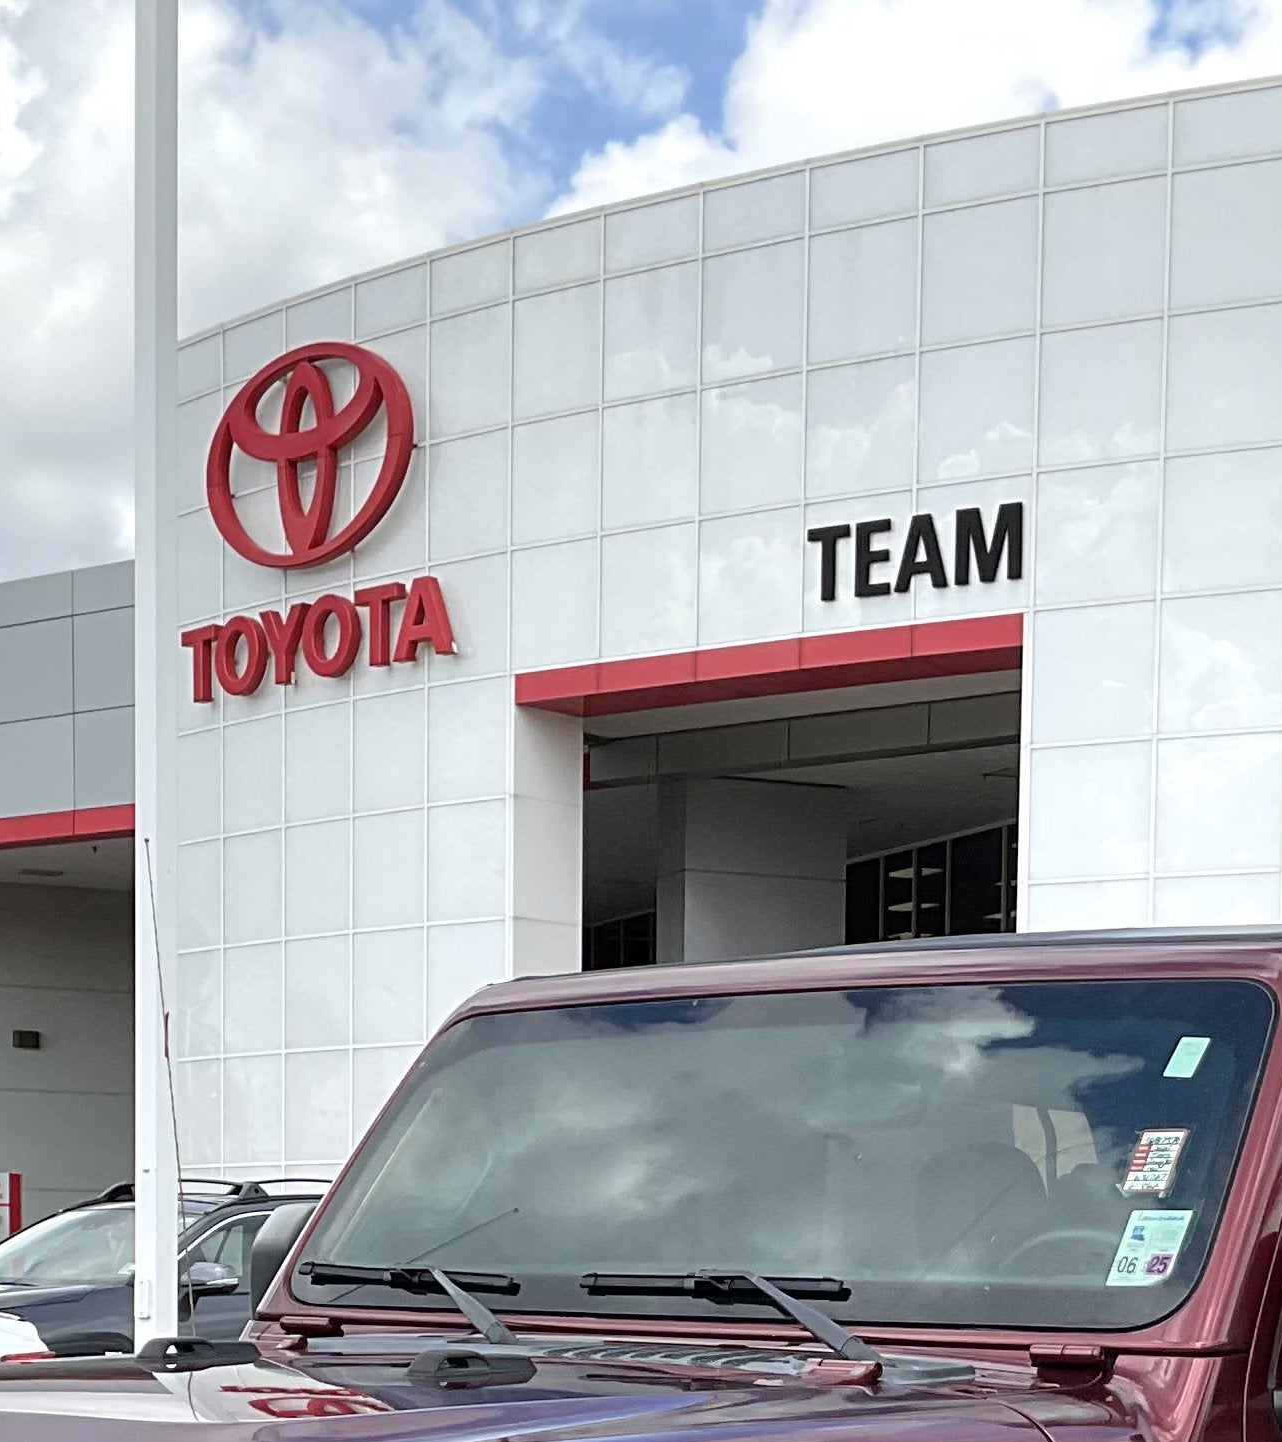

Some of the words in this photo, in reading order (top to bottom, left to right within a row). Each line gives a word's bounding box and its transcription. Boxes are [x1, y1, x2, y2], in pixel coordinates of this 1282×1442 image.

[807, 502, 1023, 602] TEAM
[181, 575, 457, 704] TOYOTA
[1117, 1255, 1139, 1274] 06
[1146, 1255, 1172, 1274] 25
